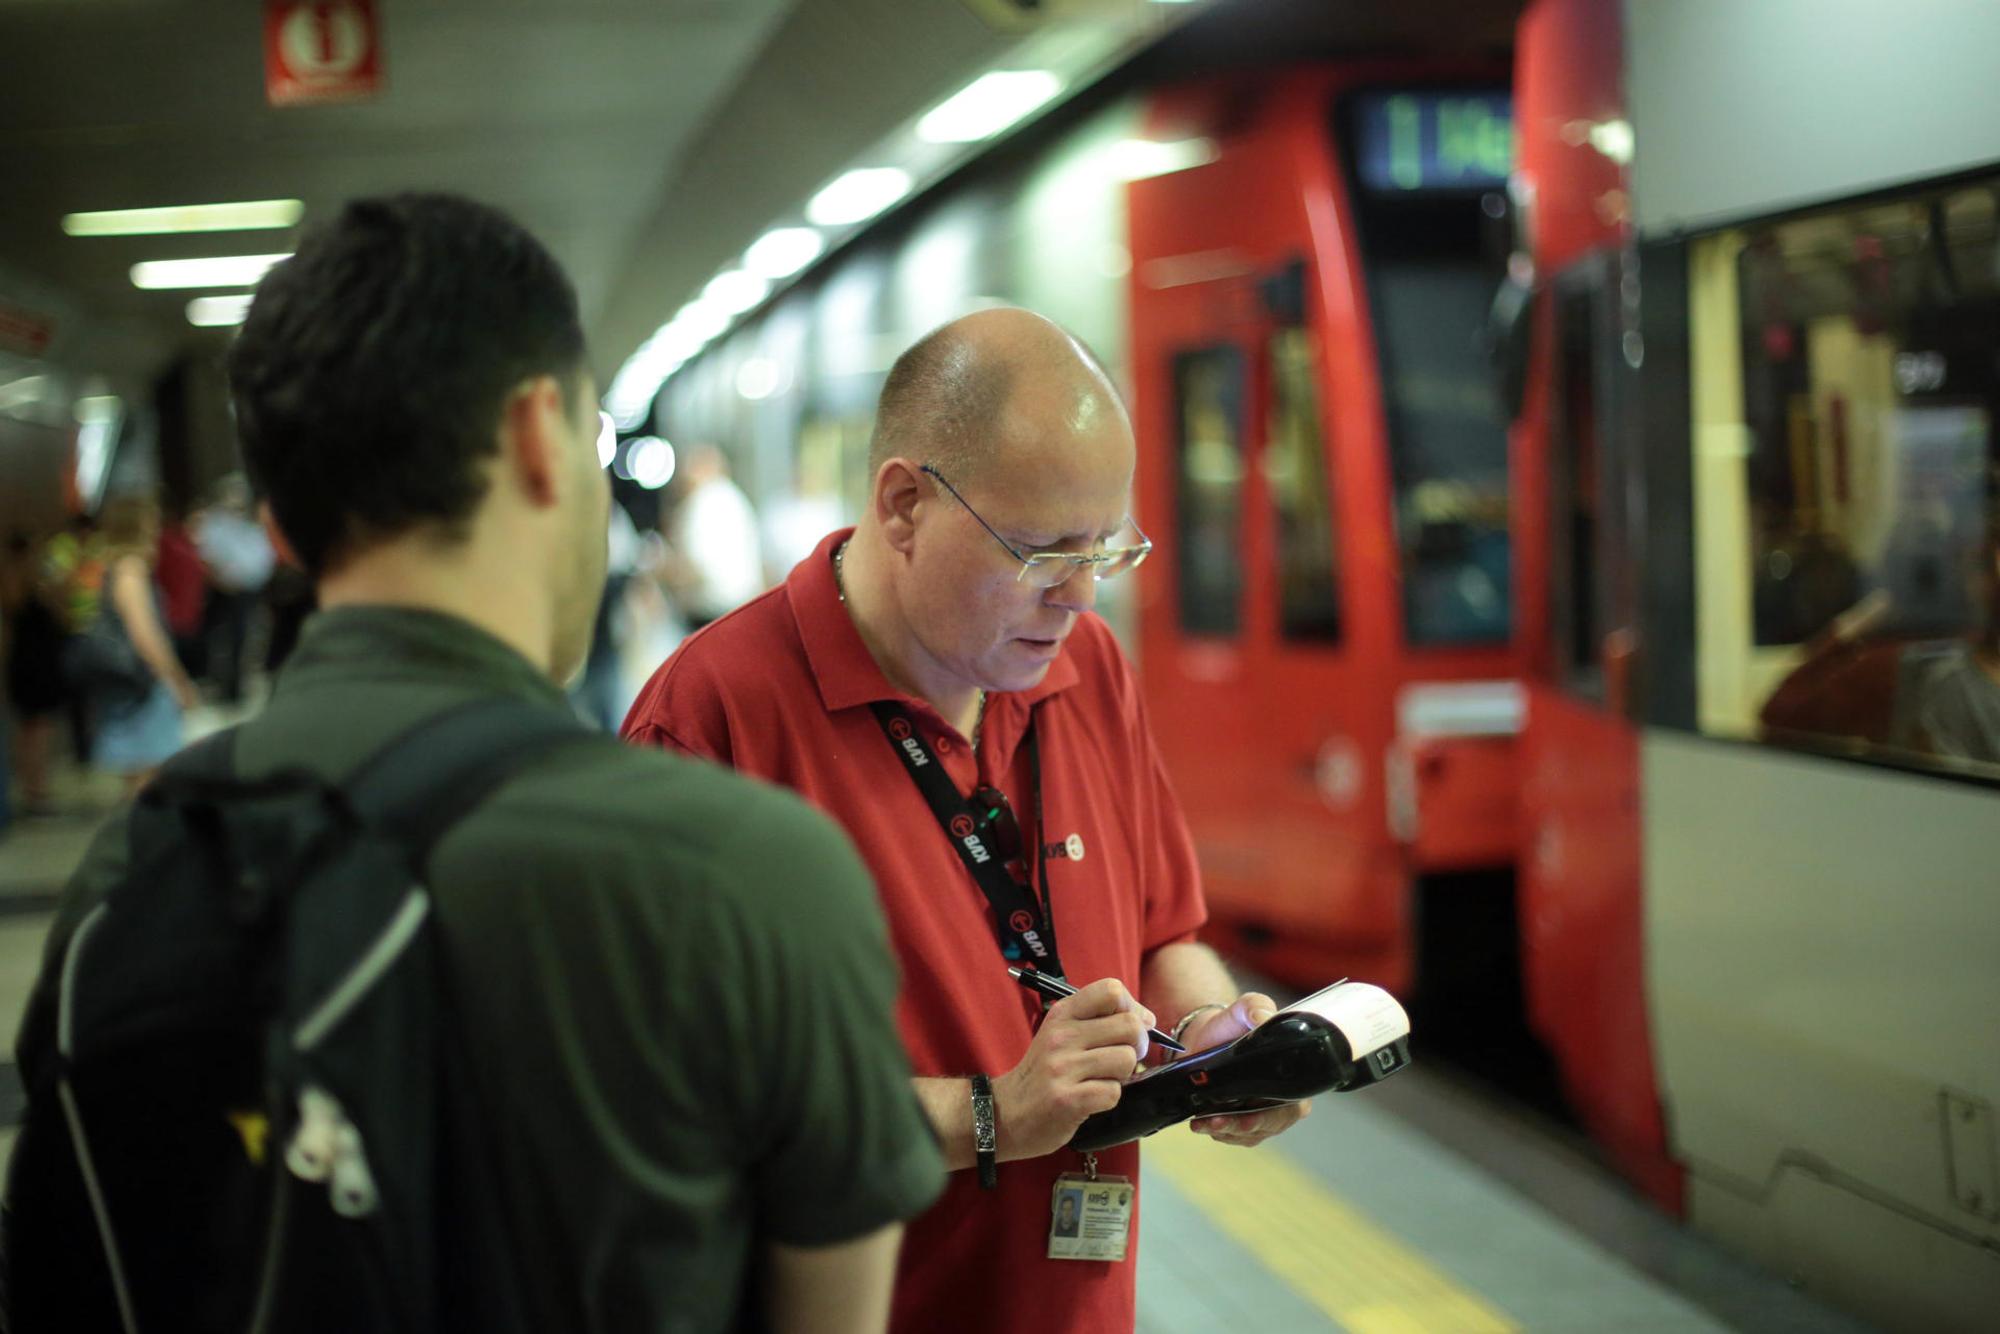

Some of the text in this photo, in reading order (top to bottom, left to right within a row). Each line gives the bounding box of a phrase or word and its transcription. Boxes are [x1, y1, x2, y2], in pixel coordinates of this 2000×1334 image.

[902, 738, 928, 766] KVB
[963, 834, 990, 863] KVB
[1023, 930, 1047, 957] KVB
